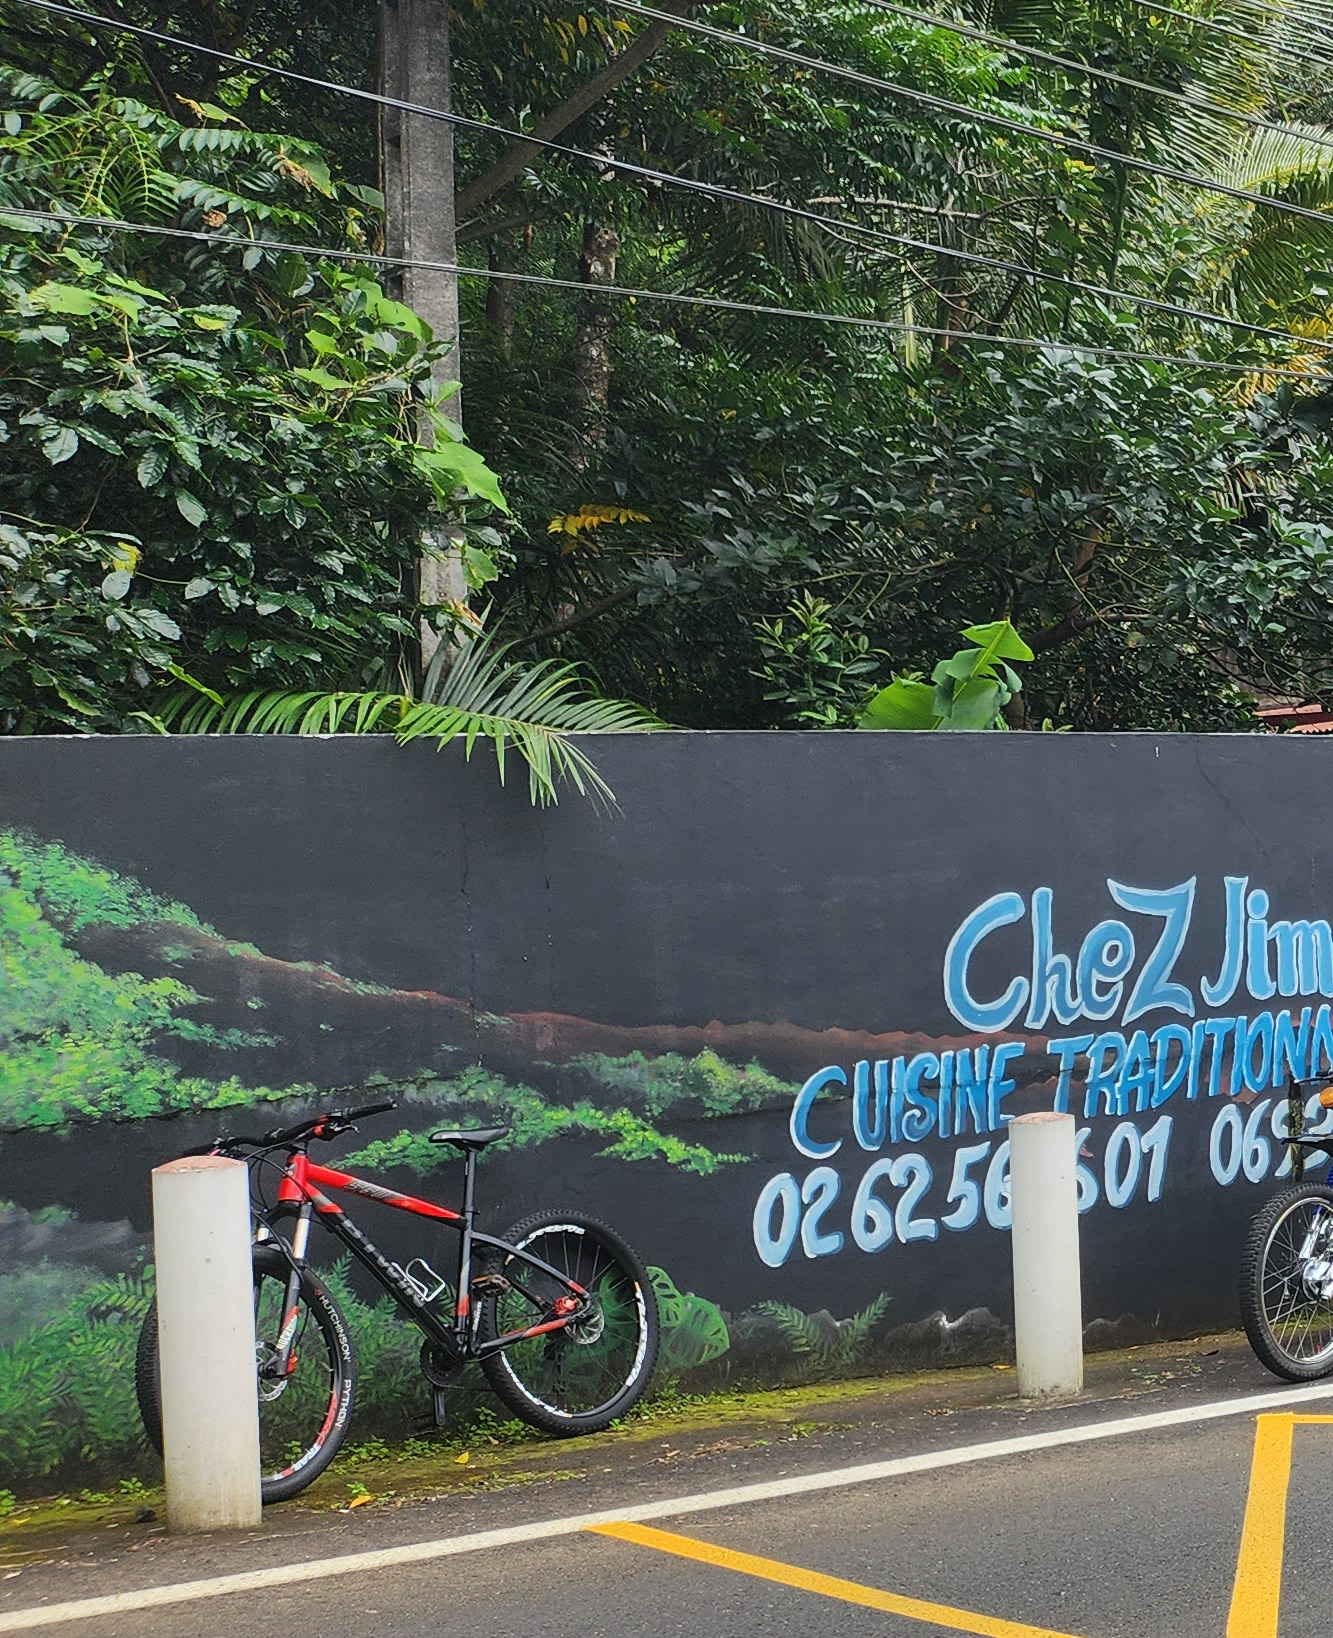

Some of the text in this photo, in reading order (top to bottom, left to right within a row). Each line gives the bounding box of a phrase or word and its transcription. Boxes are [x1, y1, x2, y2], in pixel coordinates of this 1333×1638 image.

[789, 1042, 1026, 1160] CUISINE
[319, 1295, 351, 1363] HUTCHINSON
[335, 1379, 352, 1428] PYTHON
